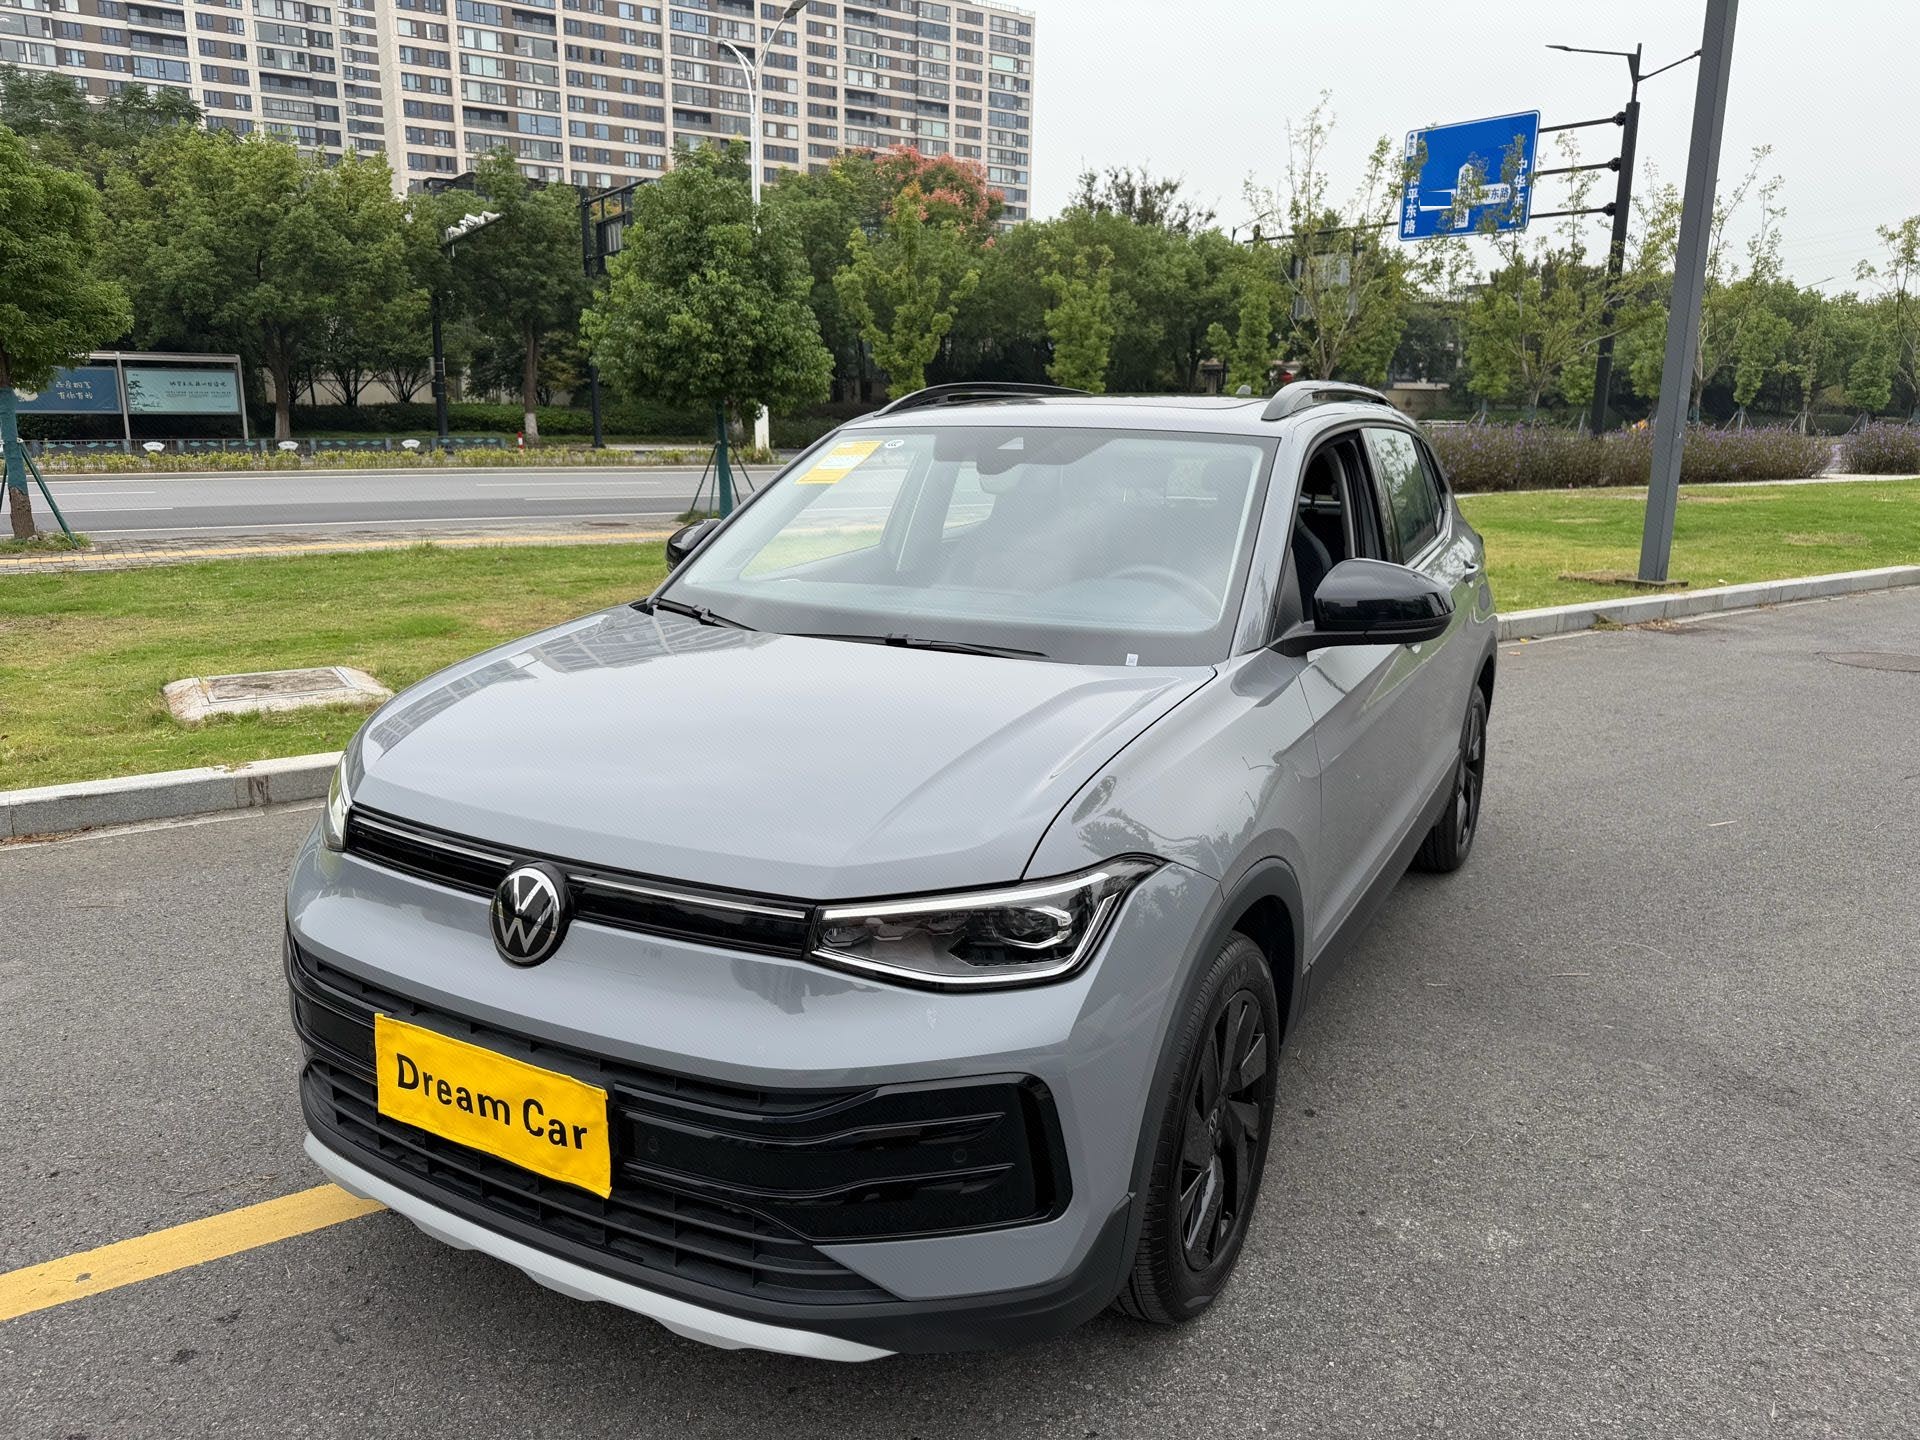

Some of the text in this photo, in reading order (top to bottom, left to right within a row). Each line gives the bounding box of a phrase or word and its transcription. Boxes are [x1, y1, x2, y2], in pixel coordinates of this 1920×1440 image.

[1509, 157, 1527, 225] 中华东
[494, 867, 558, 957] VW
[397, 1053, 588, 1150] Dream Car
